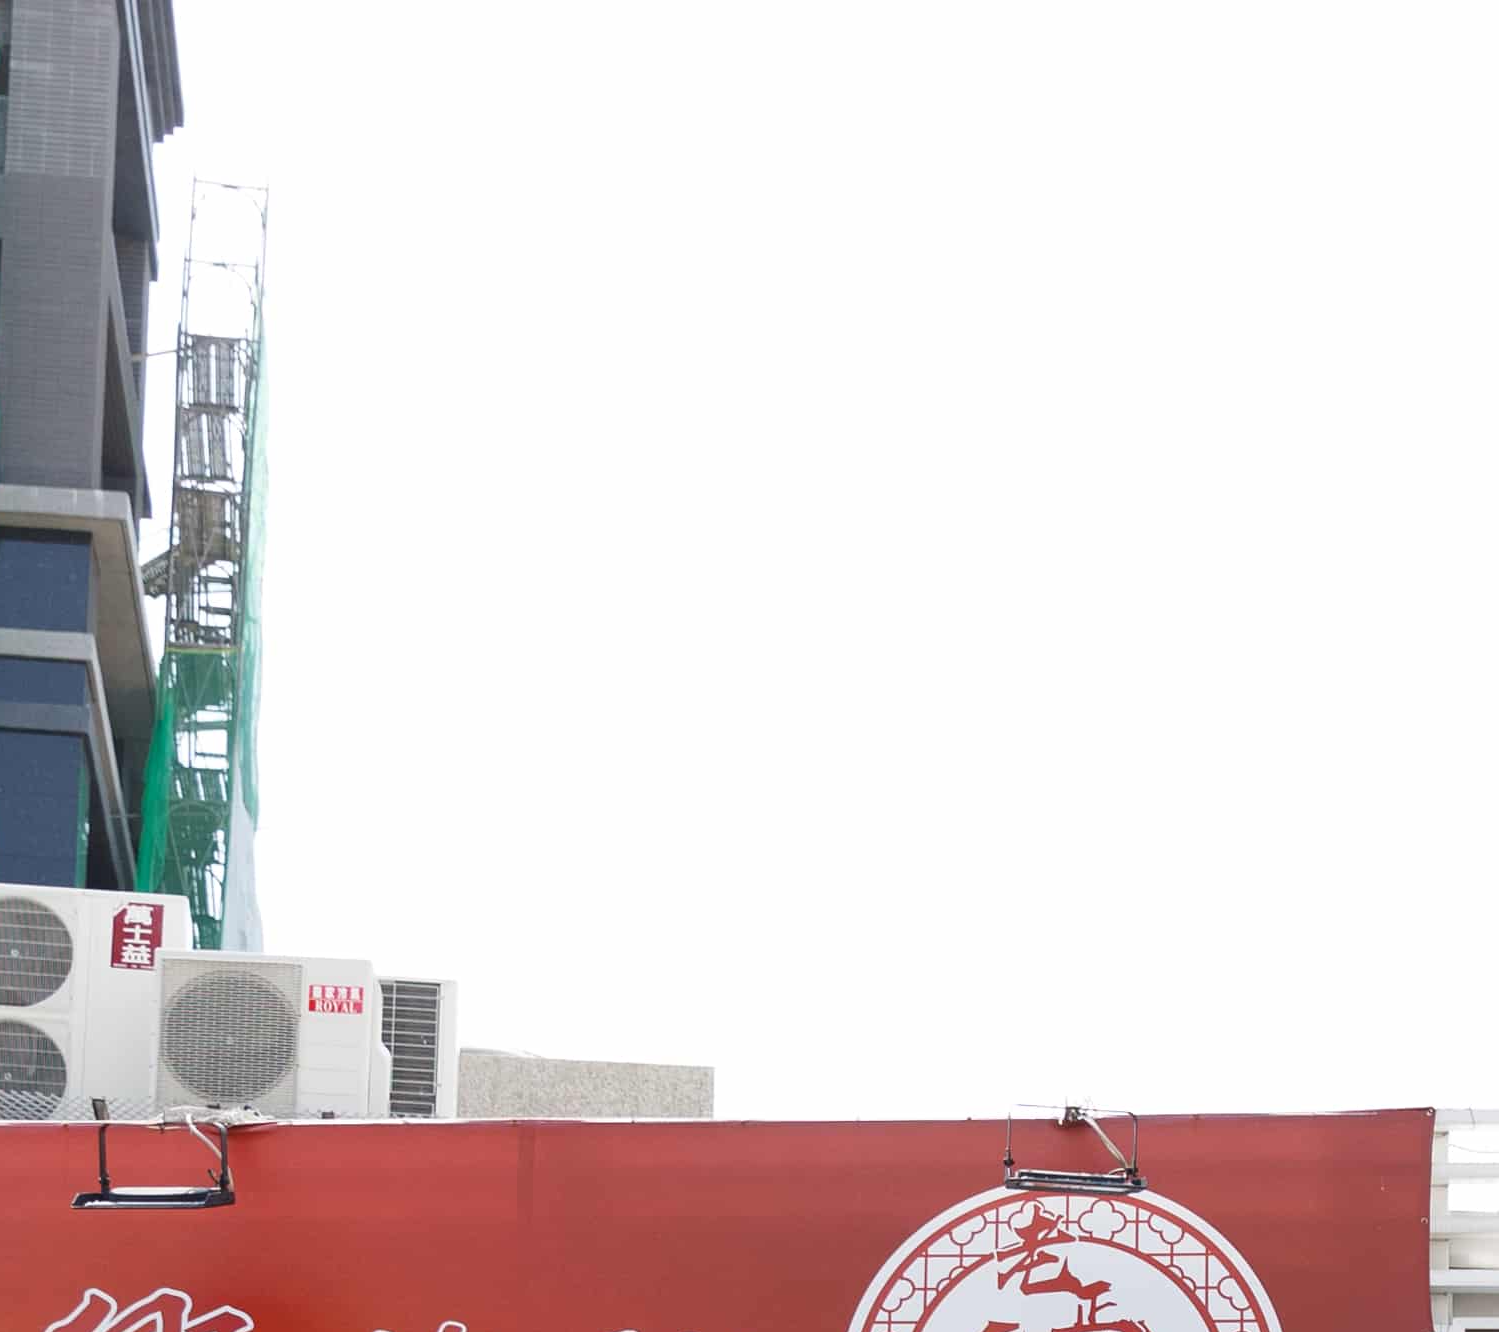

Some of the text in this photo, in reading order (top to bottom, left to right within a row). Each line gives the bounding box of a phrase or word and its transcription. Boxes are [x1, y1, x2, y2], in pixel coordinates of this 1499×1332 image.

[120, 903, 154, 964] 萬士益
[315, 999, 359, 1015] ROYAL
